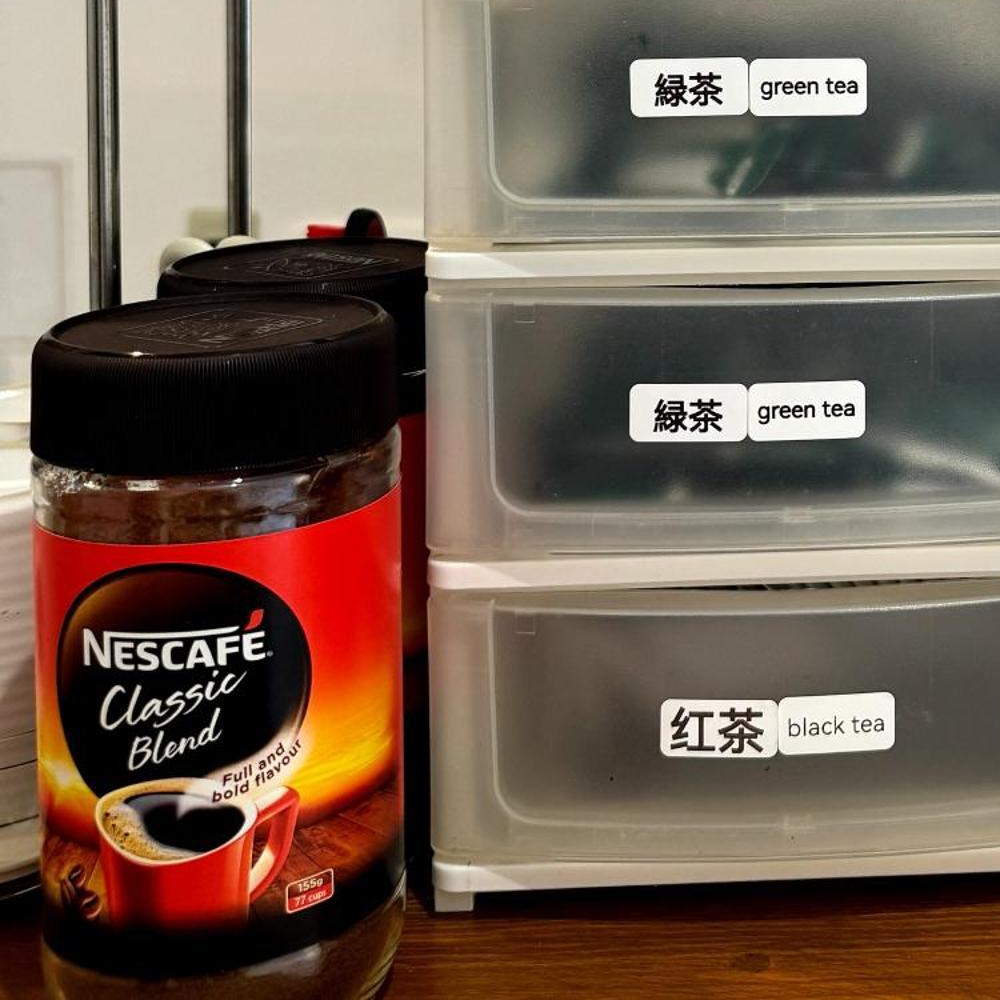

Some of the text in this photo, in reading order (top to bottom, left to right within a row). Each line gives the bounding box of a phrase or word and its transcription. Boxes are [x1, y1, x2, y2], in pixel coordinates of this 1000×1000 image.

[653, 71, 724, 108] 緑茶
[759, 76, 860, 101] green tea
[652, 397, 724, 434] 緑茶
[756, 400, 856, 426] green tea
[82, 610, 267, 672] NESCAFÉ
[100, 670, 248, 731] Classic
[127, 707, 223, 771] Blend
[669, 705, 765, 755] 红茶
[787, 714, 885, 738] black tea
[211, 739, 302, 803] bold flavour
[222, 742, 285, 787] Full and
